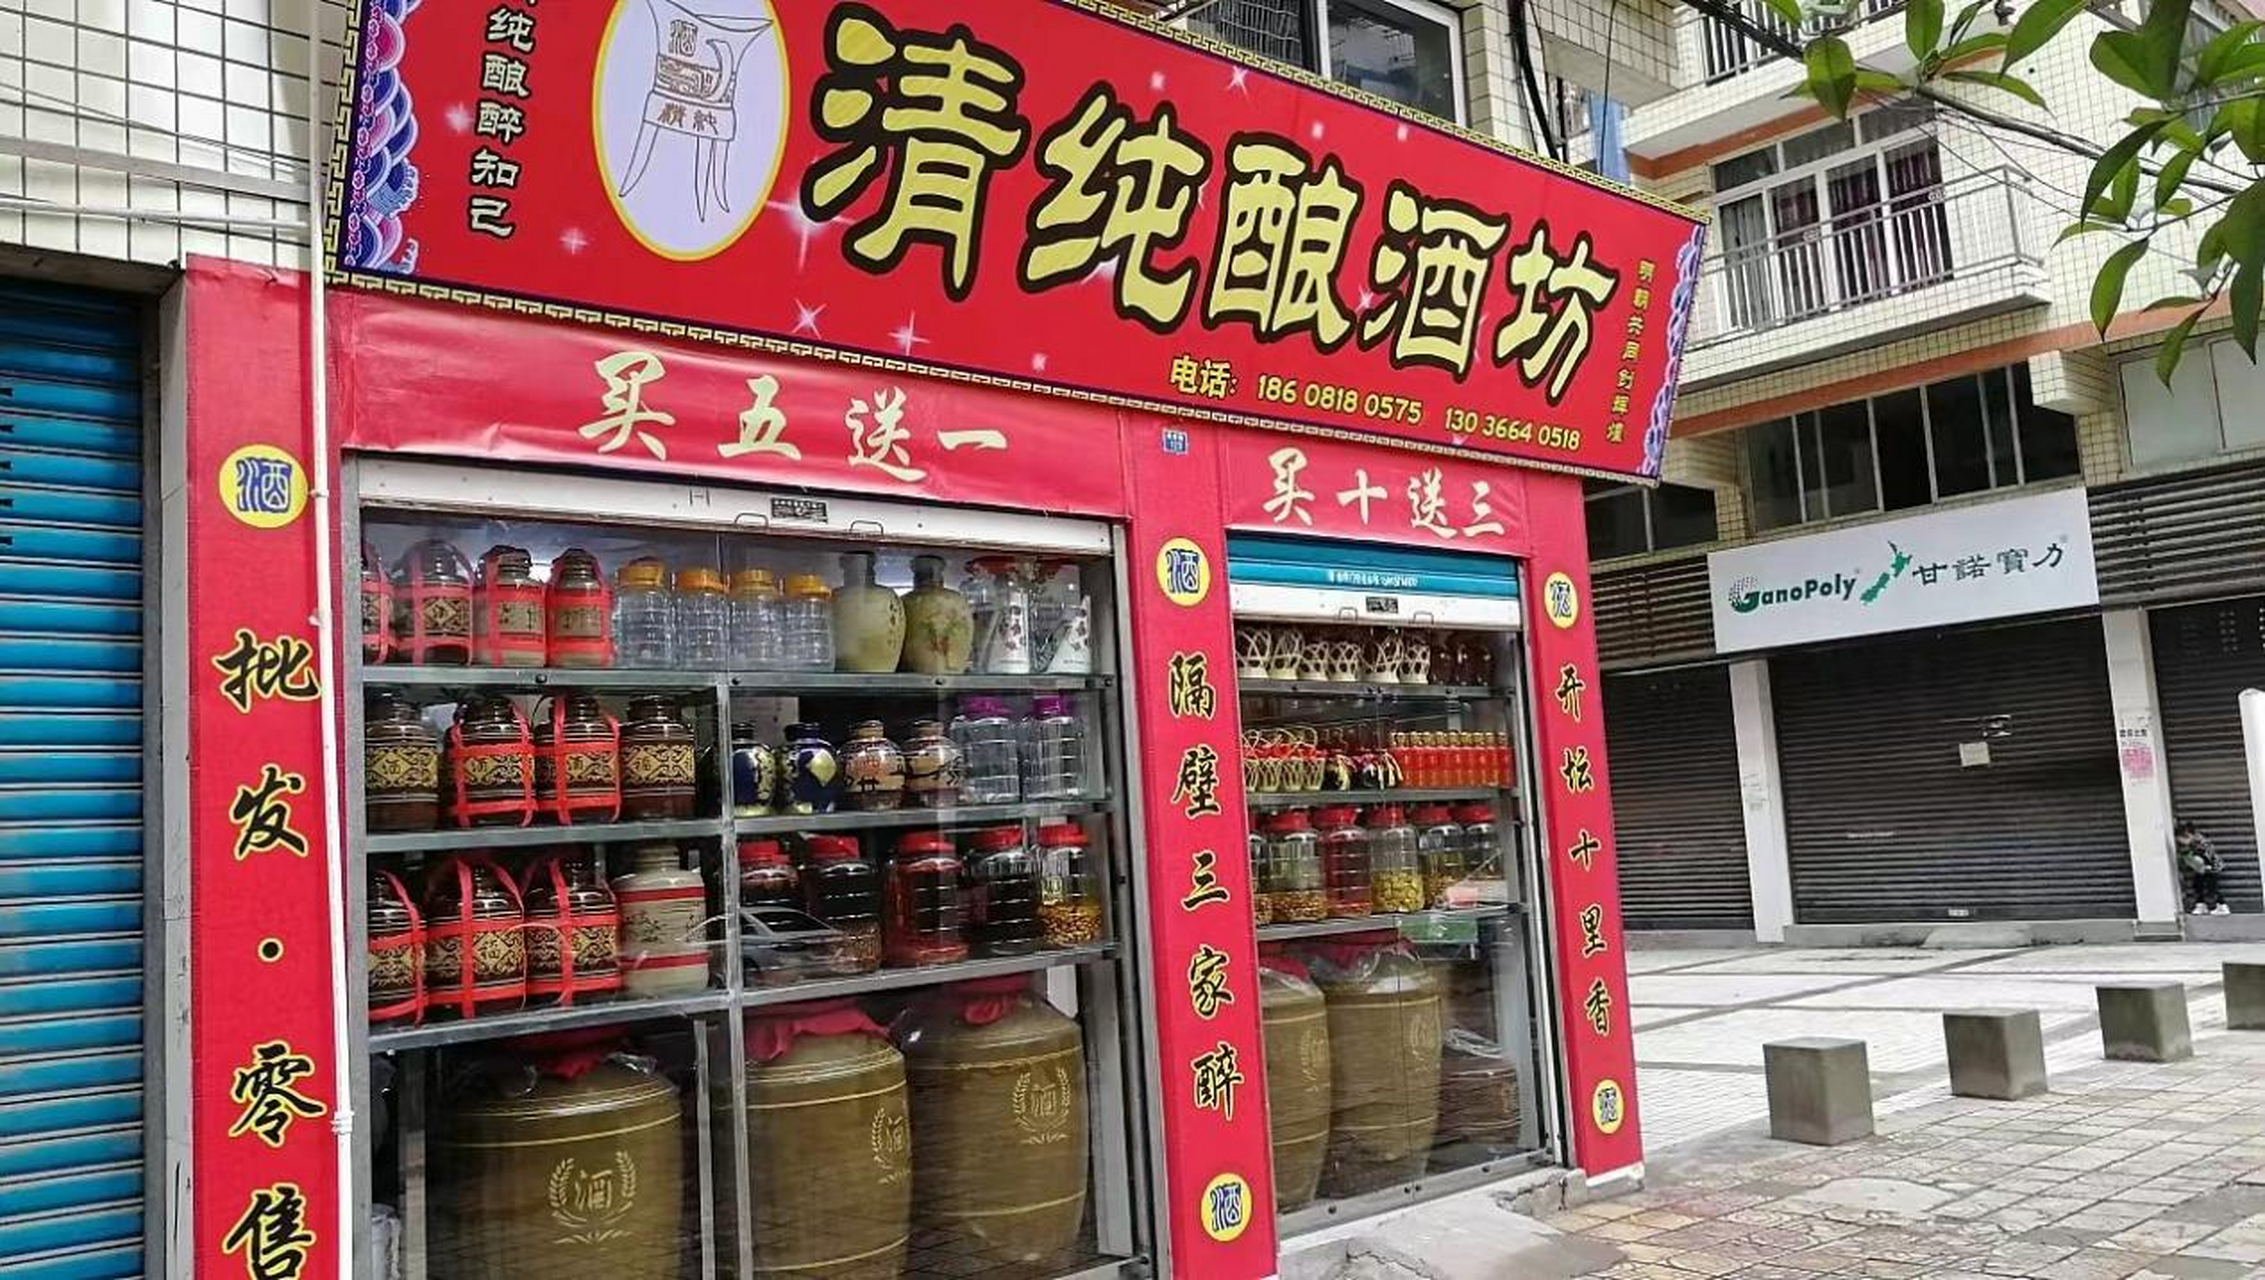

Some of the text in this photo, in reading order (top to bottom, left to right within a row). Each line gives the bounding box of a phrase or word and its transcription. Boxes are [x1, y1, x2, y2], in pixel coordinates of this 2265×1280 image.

[471, 0, 534, 237] 纯酿醉知己
[804, 3, 1618, 404] 清纯酿酒坊
[577, 350, 1008, 484] 买五送一
[1256, 376, 1298, 406] 186
[1303, 383, 1359, 414] 0818
[1364, 394, 1424, 427] 0575
[1443, 407, 1478, 434] 130
[1482, 415, 1533, 443] 3664
[1537, 422, 1581, 451] 0518
[1261, 446, 1506, 541] 买十送三
[1167, 651, 1245, 1121] 隔壁三家醉
[1555, 662, 1613, 1037] 开坛十里香
[574, 1169, 613, 1211] 酒
